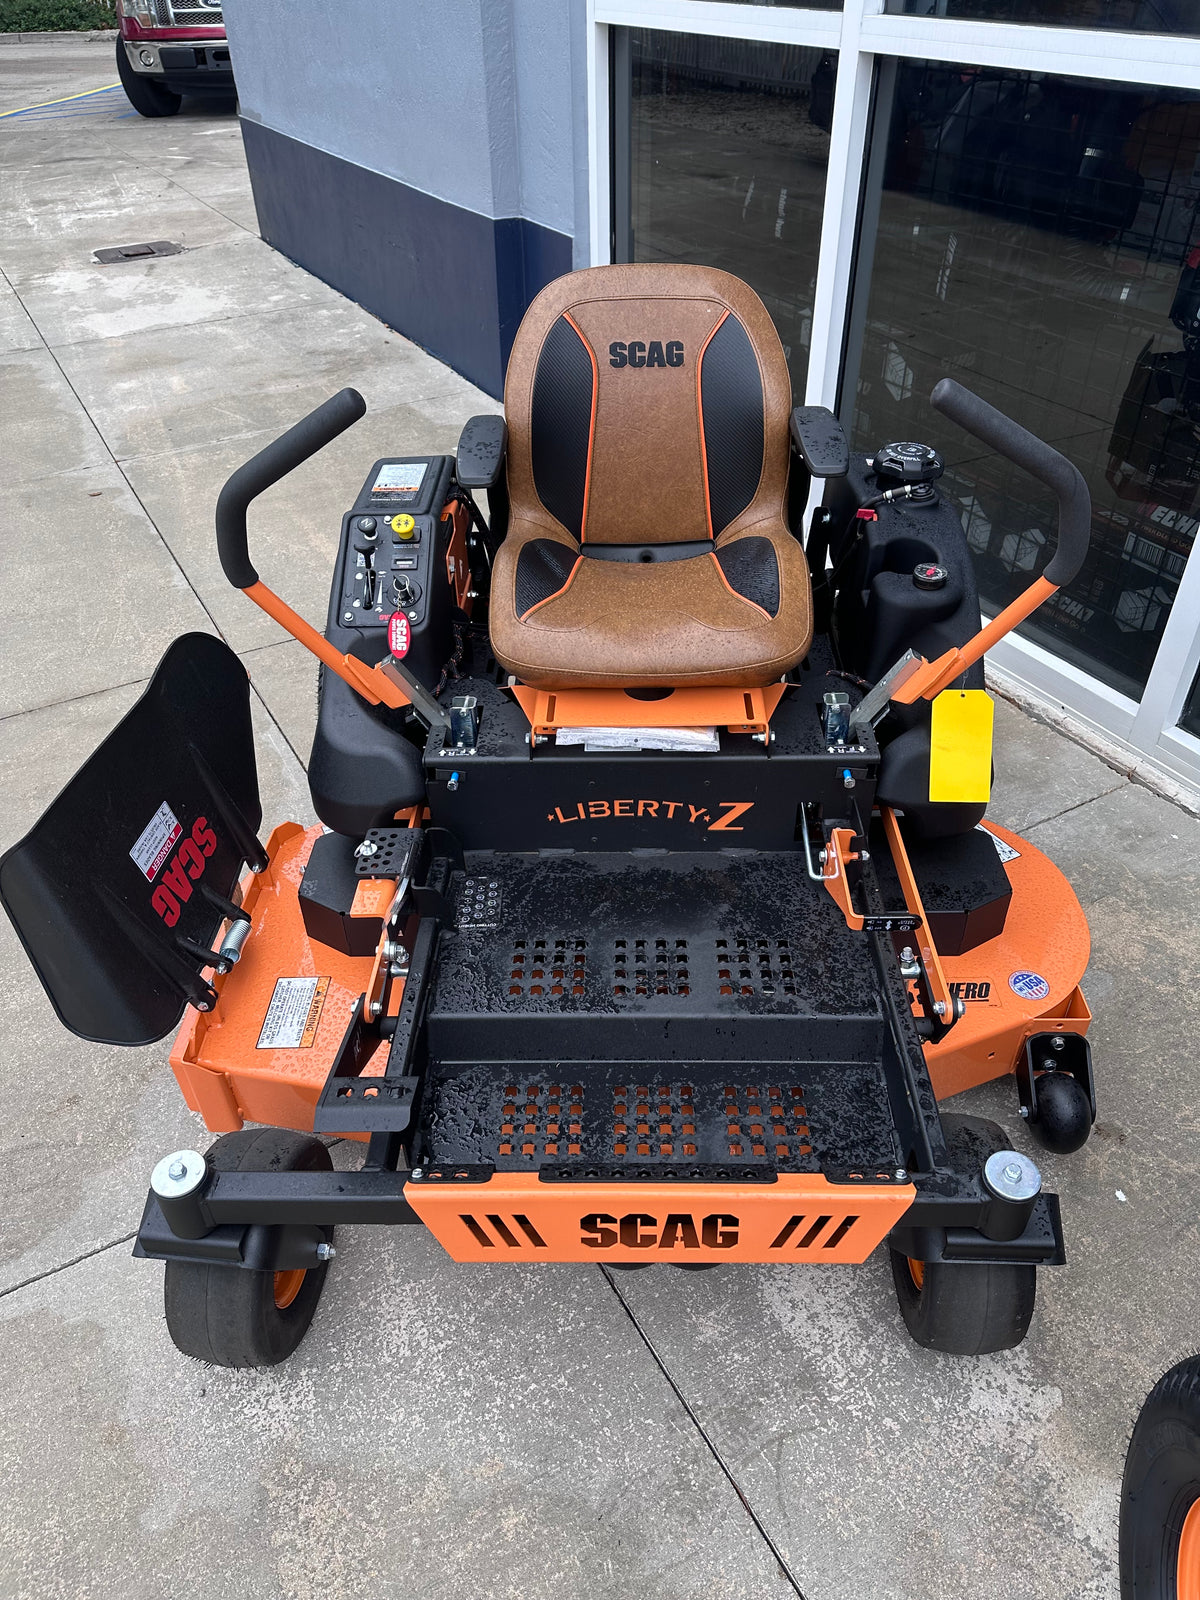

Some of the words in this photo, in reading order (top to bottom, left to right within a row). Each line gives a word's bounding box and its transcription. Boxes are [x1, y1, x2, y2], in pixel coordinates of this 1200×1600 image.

[609, 341, 684, 368] SCAG
[396, 619, 407, 651] SCAG
[555, 800, 707, 823] LIBERTY
[707, 802, 755, 831] Z
[151, 838, 172, 871] DANGER
[152, 816, 217, 928] SCAG
[1023, 976, 1045, 990] USA
[305, 999, 320, 1031] WARNING
[580, 1213, 740, 1248] SCAG
